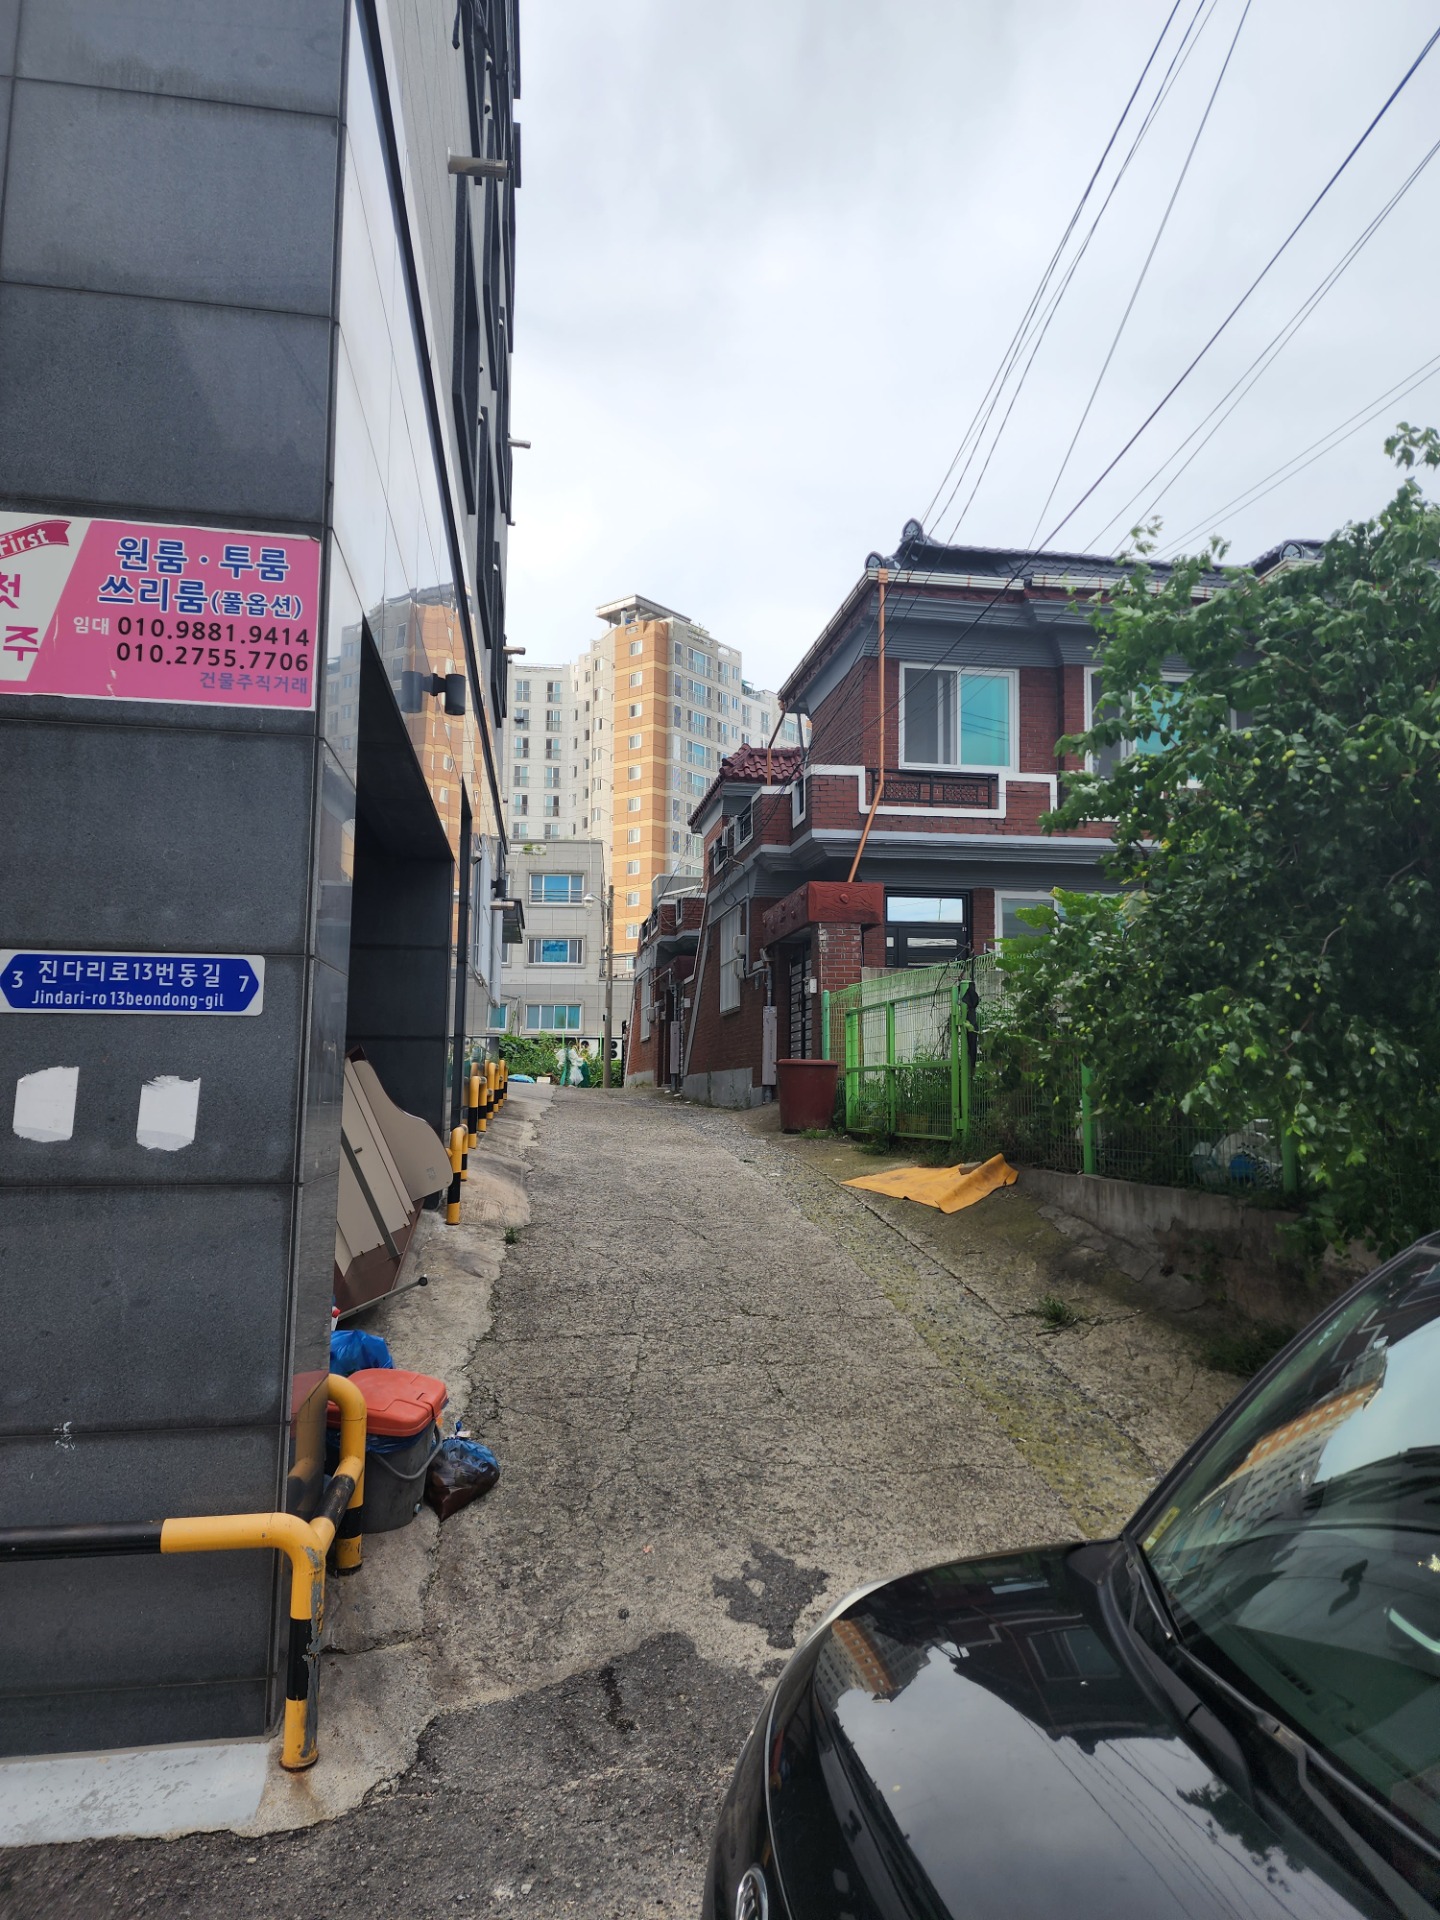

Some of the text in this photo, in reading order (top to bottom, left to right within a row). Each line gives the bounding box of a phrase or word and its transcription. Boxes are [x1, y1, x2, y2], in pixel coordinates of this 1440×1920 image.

[115, 536, 291, 583] 원룸 투룸
[3, 626, 40, 662] 주
[73, 616, 310, 647] 임대 010.9881.9414
[116, 642, 309, 672] 010.2755.7706
[199, 671, 308, 694] 건물주직거래
[11, 960, 250, 992] 3 진다리로13번동길 7
[32, 990, 224, 1009] Jindari-ro 13beondong-gil
